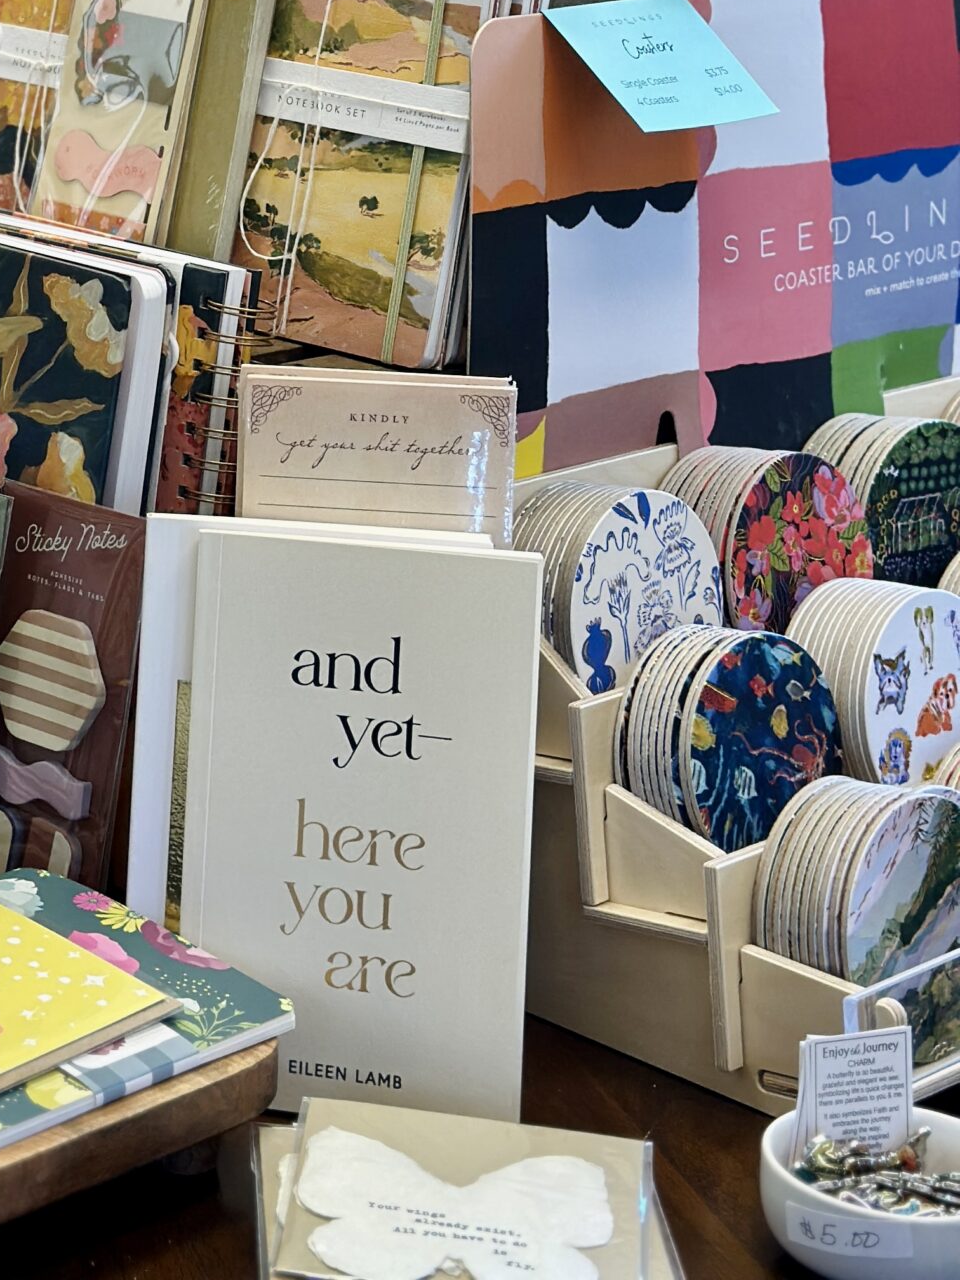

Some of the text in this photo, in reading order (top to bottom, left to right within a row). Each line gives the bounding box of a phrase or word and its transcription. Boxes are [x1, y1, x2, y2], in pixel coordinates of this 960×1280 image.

[620, 79, 647, 89] Single
[647, 76, 679, 87] Coaster
[637, 98, 644, 106] 4
[644, 96, 680, 106] Coasters
[346, 107, 367, 119] SET
[723, 198, 947, 264] SEEDLIN
[774, 264, 843, 292] COASTER
[847, 257, 878, 279] BAR
[882, 251, 901, 272] OF
[905, 242, 947, 267] YOUR
[865, 286, 881, 296] mix
[890, 277, 915, 292] match
[916, 276, 924, 286] to
[926, 272, 949, 284] create
[349, 412, 410, 424] KINDLY
[276, 431, 483, 470] get your shit together
[15, 523, 128, 562] Sticky Notes
[50, 570, 83, 585] ADHESIVE
[54, 582, 75, 593] FLAGS
[87, 592, 104, 602] TABS
[290, 635, 402, 695] and
[292, 797, 426, 870] here
[279, 879, 392, 936] you
[324, 949, 417, 998] are
[822, 1046, 850, 1060] Enjoy
[862, 1041, 899, 1054] Journey
[847, 1057, 876, 1068] CHARM
[287, 1059, 403, 1090] EILEEN LAMB
[832, 1070, 855, 1080] butterfly
[818, 1088, 851, 1100] symbolizing
[865, 1084, 880, 1094] quick
[880, 1081, 905, 1092] changes
[822, 1080, 844, 1091] graceful
[818, 1098, 833, 1107] there
[834, 1097, 844, 1105] are
[844, 1095, 869, 1105] parallels
[876, 1093, 887, 1102] you
[832, 1116, 892, 1128] embraces the journey
[841, 1108, 873, 1119] symbolizes
[842, 1125, 858, 1136] along
[858, 1125, 868, 1133] the
[368, 1201, 446, 1219] Your wings
[393, 1226, 528, 1248] All you have to do
[414, 1217, 522, 1238] already exist.
[799, 1216, 881, 1249] $5.00
[506, 1260, 536, 1271] fly.
